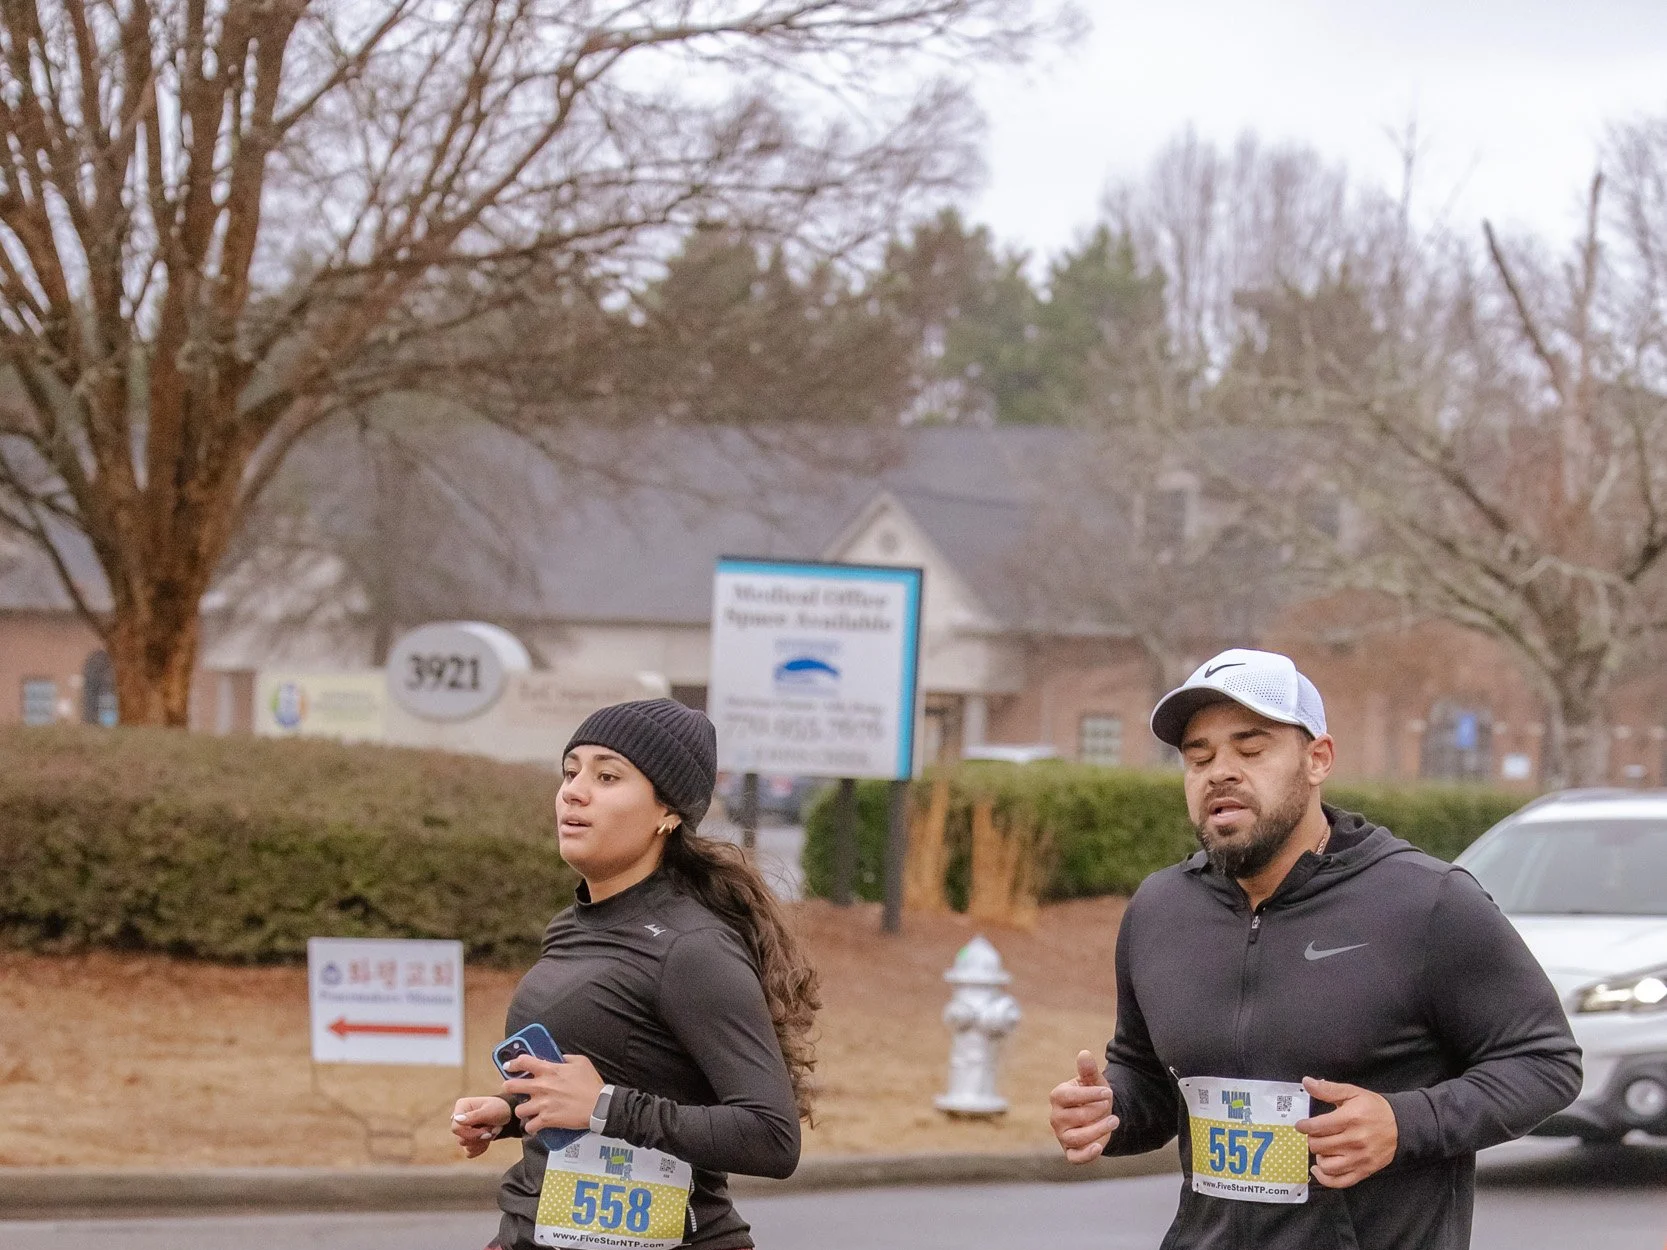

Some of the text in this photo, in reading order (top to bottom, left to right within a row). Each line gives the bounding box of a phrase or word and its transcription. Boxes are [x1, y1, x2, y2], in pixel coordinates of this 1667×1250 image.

[404, 655, 480, 692] 3921
[1209, 1126, 1274, 1176] 557
[1202, 1180, 1289, 1195] www.FiveStarNTP.com
[571, 1180, 653, 1233] 558
[552, 1231, 664, 1248] www.FiveStarNTP.com
